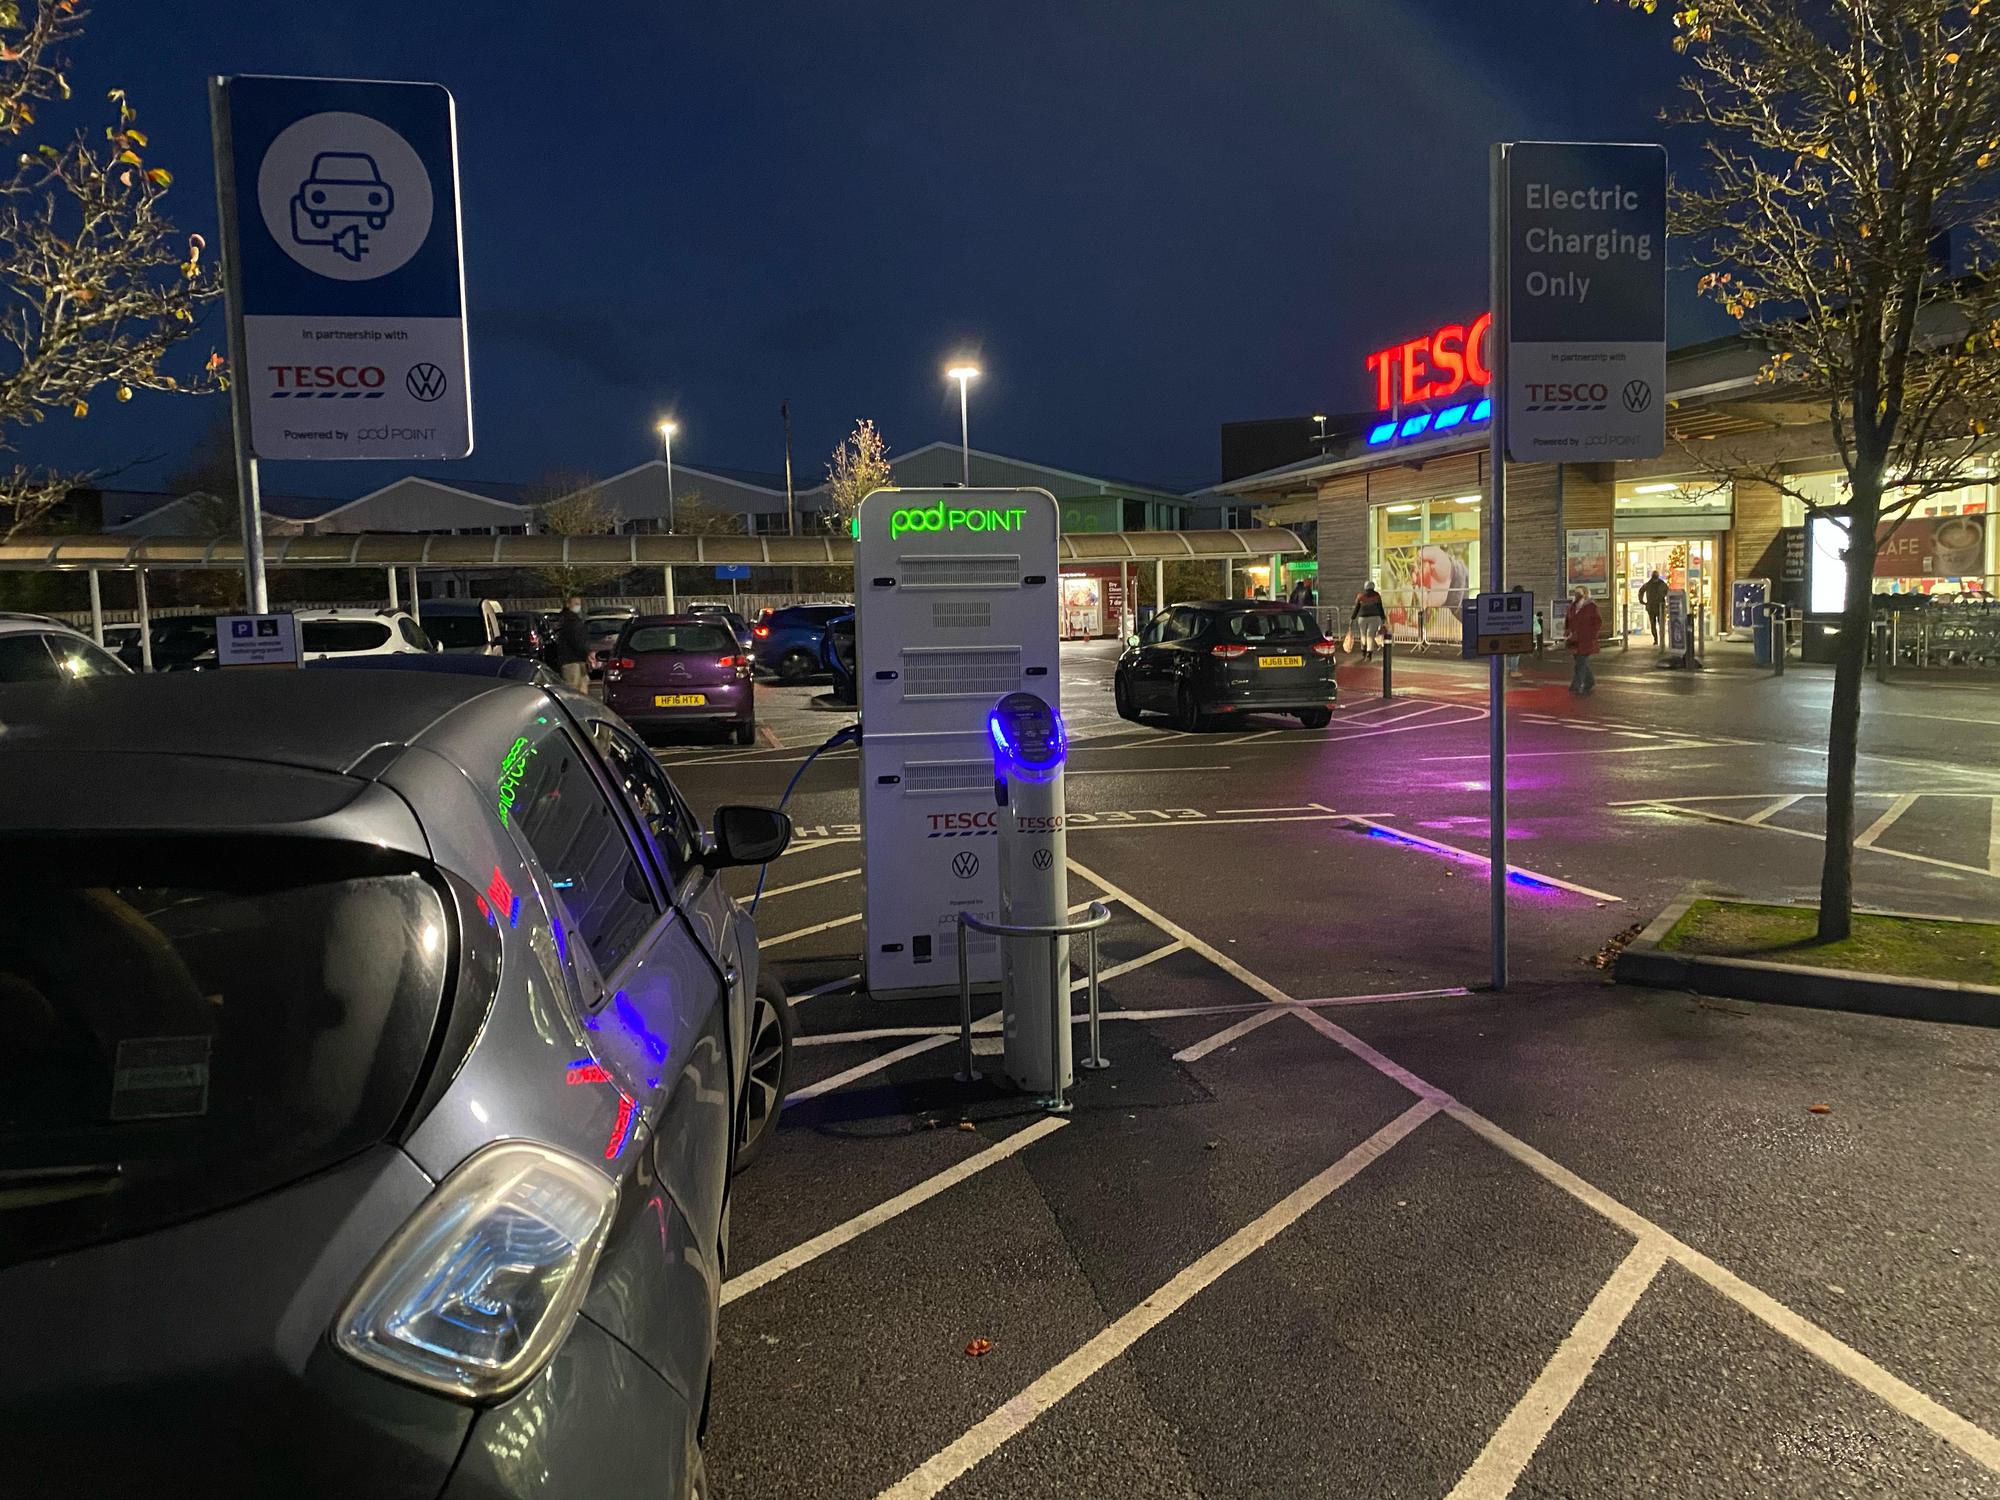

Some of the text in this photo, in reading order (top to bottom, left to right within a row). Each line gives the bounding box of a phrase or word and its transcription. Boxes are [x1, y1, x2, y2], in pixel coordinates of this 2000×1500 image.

[1526, 184, 1638, 210] Electric
[1526, 228, 1651, 261] Charging
[1526, 271, 1590, 302] Only
[302, 329, 408, 341] In partnership with
[1367, 312, 1492, 411] TESC
[1561, 353, 1608, 362] partnership
[1609, 353, 1626, 361] with
[268, 365, 386, 388] TESCO
[1524, 383, 1608, 402] TESCO
[284, 430, 332, 440] Powered
[336, 429, 349, 441] by
[392, 428, 436, 441] POINT
[890, 500, 1027, 541] pod POINT
[1876, 538, 1920, 556] AFE
[1493, 600, 1500, 611] P
[238, 624, 248, 635] P
[1263, 658, 1282, 666] HJ68
[662, 695, 699, 705] HF16 HTX
[1017, 815, 1063, 829] TESCO
